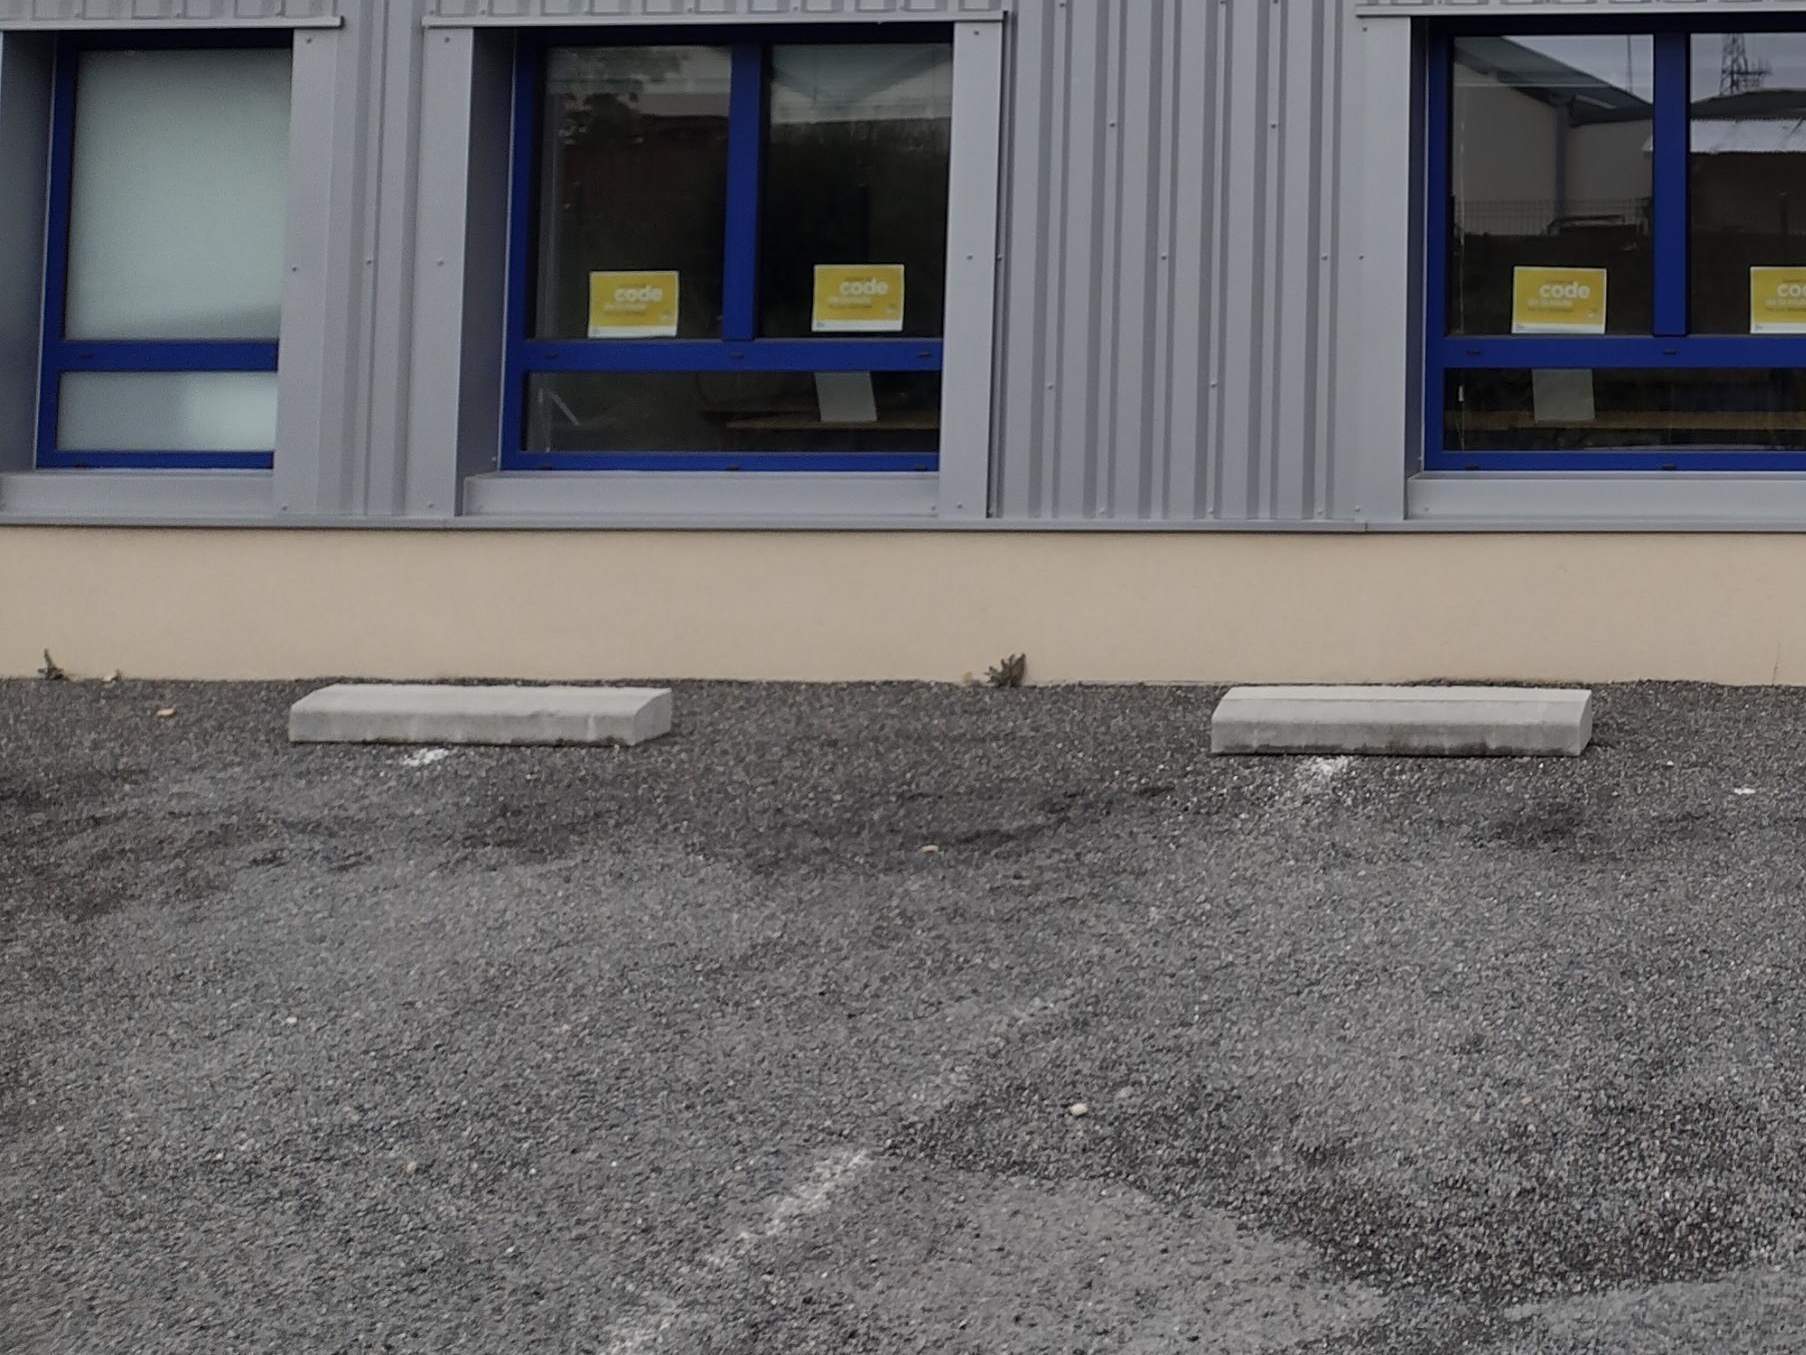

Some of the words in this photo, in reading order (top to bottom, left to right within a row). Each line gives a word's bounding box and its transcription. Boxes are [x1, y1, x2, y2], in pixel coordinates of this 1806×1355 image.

[614, 285, 663, 302] code
[839, 277, 888, 295] code
[1538, 281, 1590, 299] code
